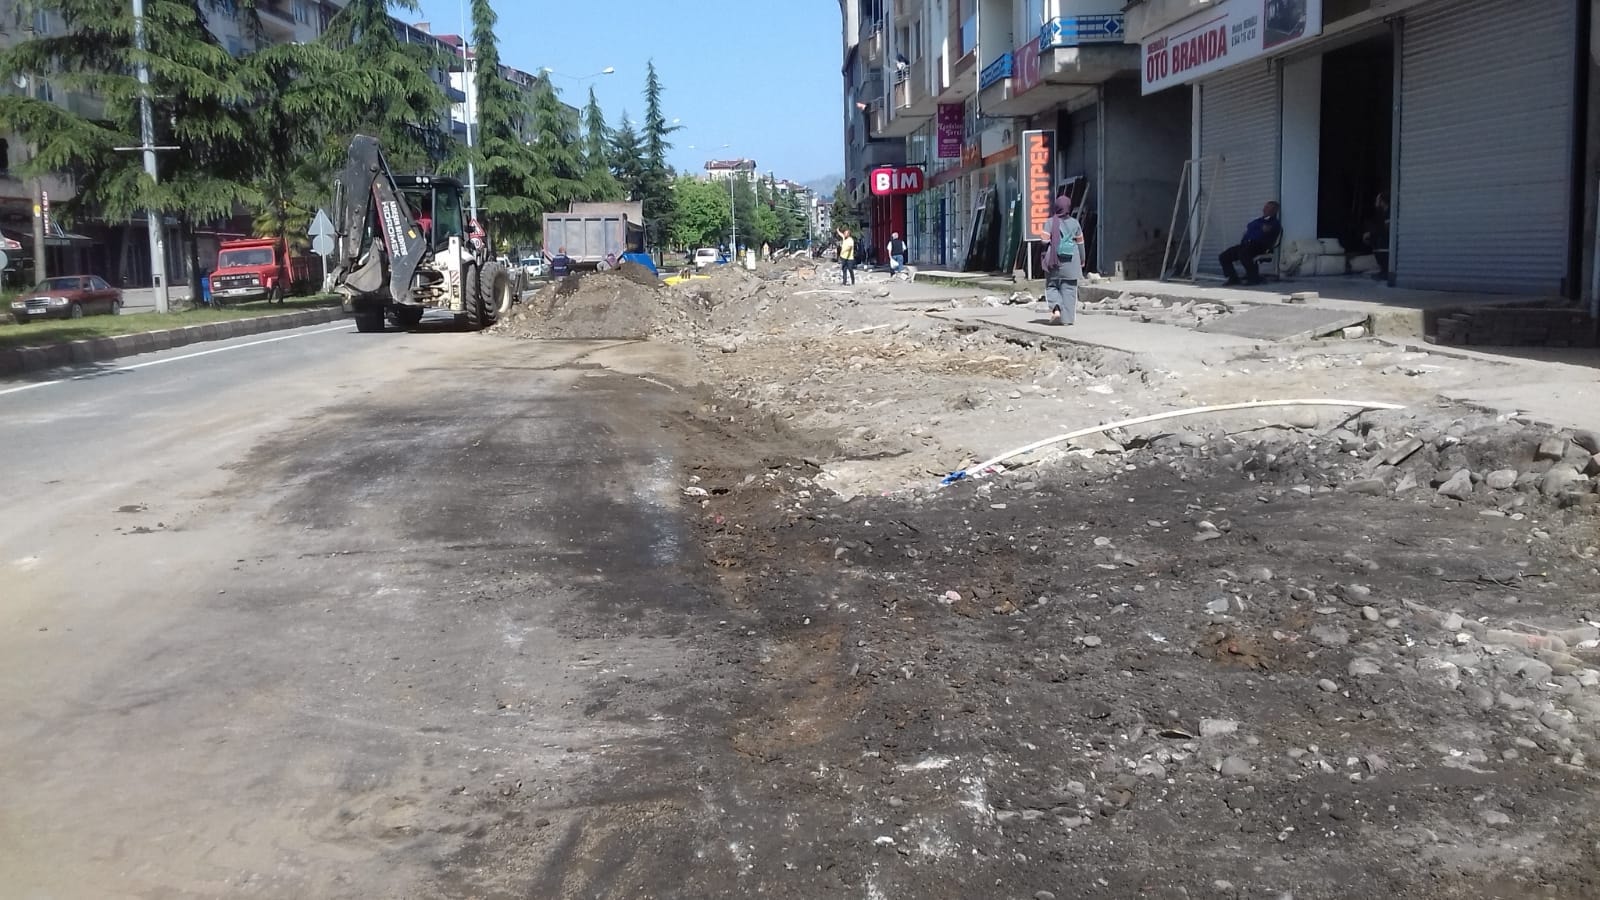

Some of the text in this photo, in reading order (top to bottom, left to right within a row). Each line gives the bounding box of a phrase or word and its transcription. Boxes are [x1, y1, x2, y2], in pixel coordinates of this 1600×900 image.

[1146, 49, 1168, 84] OTO
[1172, 25, 1227, 74] BRANDA
[876, 169, 918, 191] BİM
[1030, 136, 1049, 235] FIRATPEN
